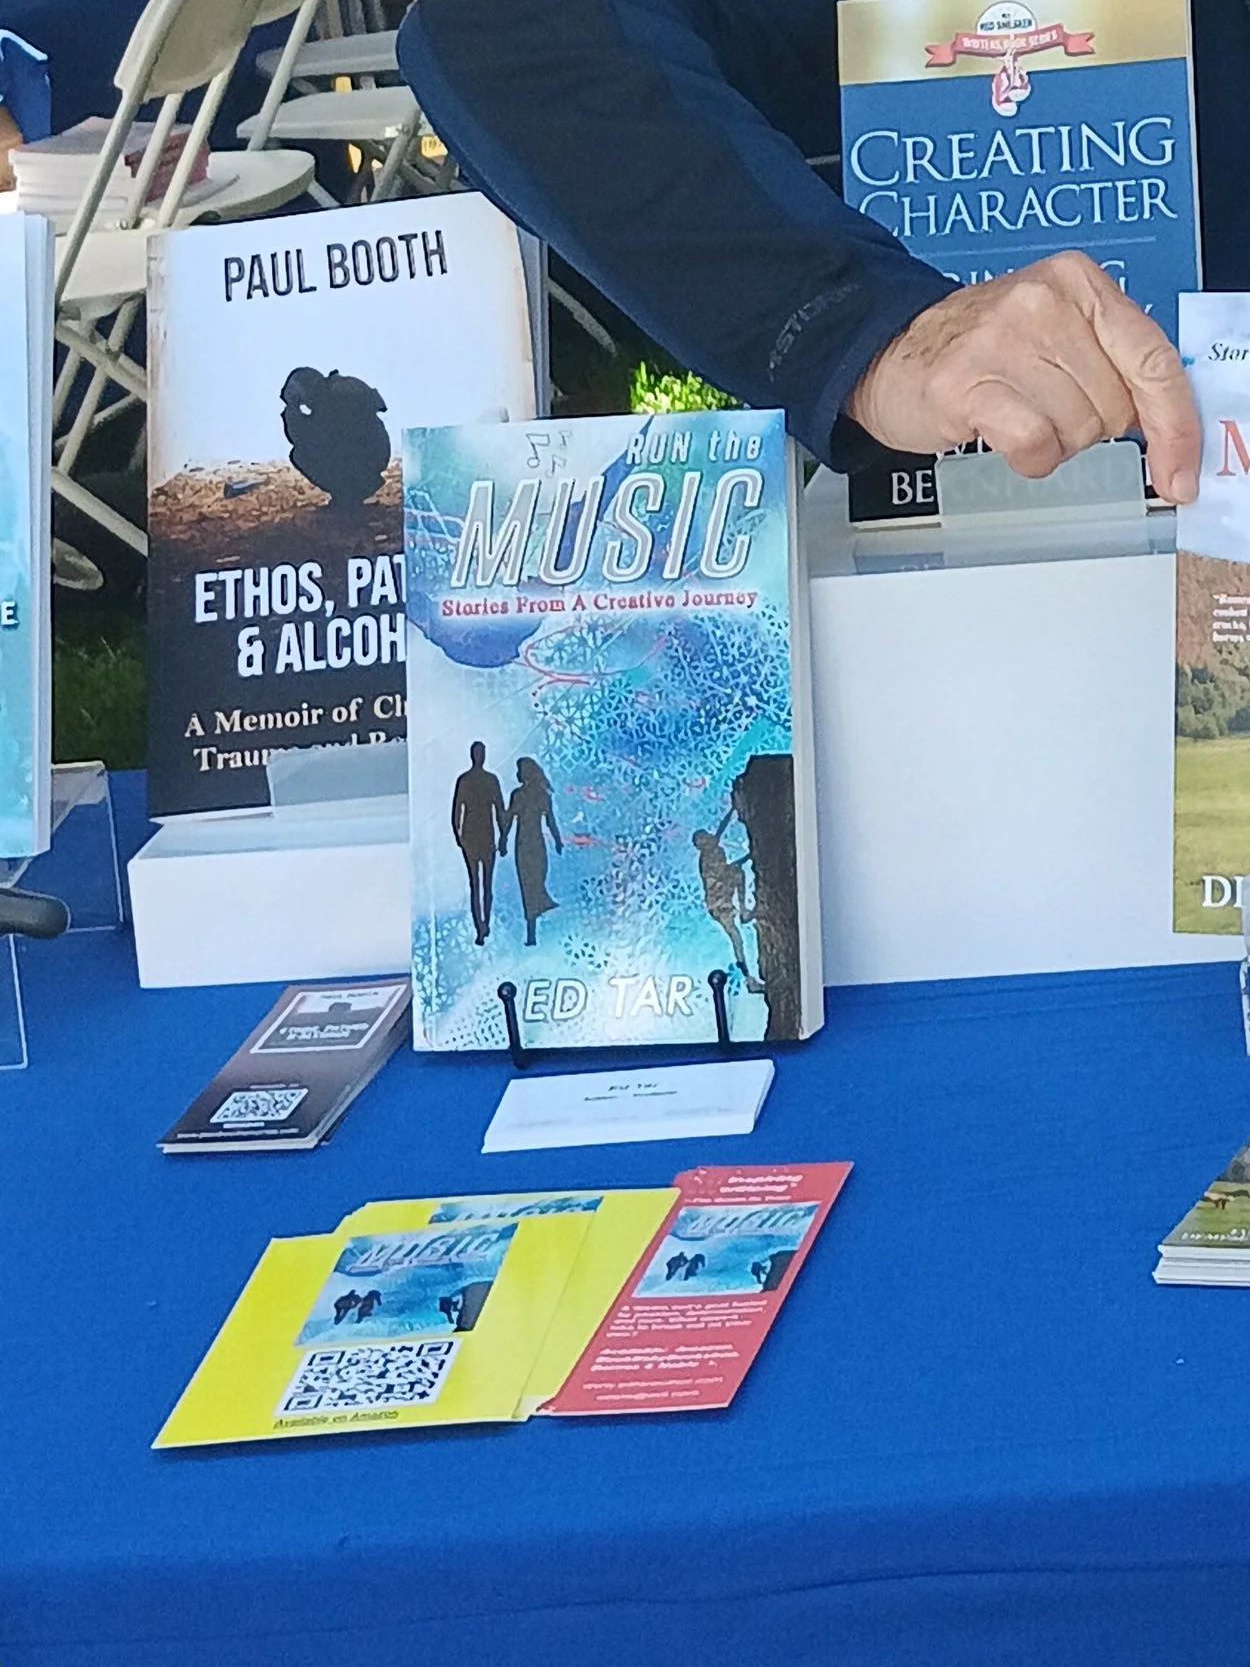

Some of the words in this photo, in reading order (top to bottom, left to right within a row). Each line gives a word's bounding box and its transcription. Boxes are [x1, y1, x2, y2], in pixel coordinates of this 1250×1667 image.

[850, 117, 1176, 186] CREATING
[860, 178, 1177, 238] CHARACTER
[224, 248, 317, 302] PAUL
[326, 229, 448, 289] BOOTH
[627, 430, 691, 465] RUN
[709, 430, 762, 462] the
[451, 468, 763, 588] MUSIC
[195, 562, 337, 623] ETHOS,
[442, 597, 509, 617] Stories
[517, 595, 565, 613] From
[572, 594, 587, 611] A
[593, 591, 675, 611] Creative
[682, 589, 758, 608] Journey
[238, 626, 266, 677] &
[184, 713, 206, 738] A
[214, 702, 324, 734] Memoir
[332, 697, 363, 723] of
[523, 977, 588, 1023] ED
